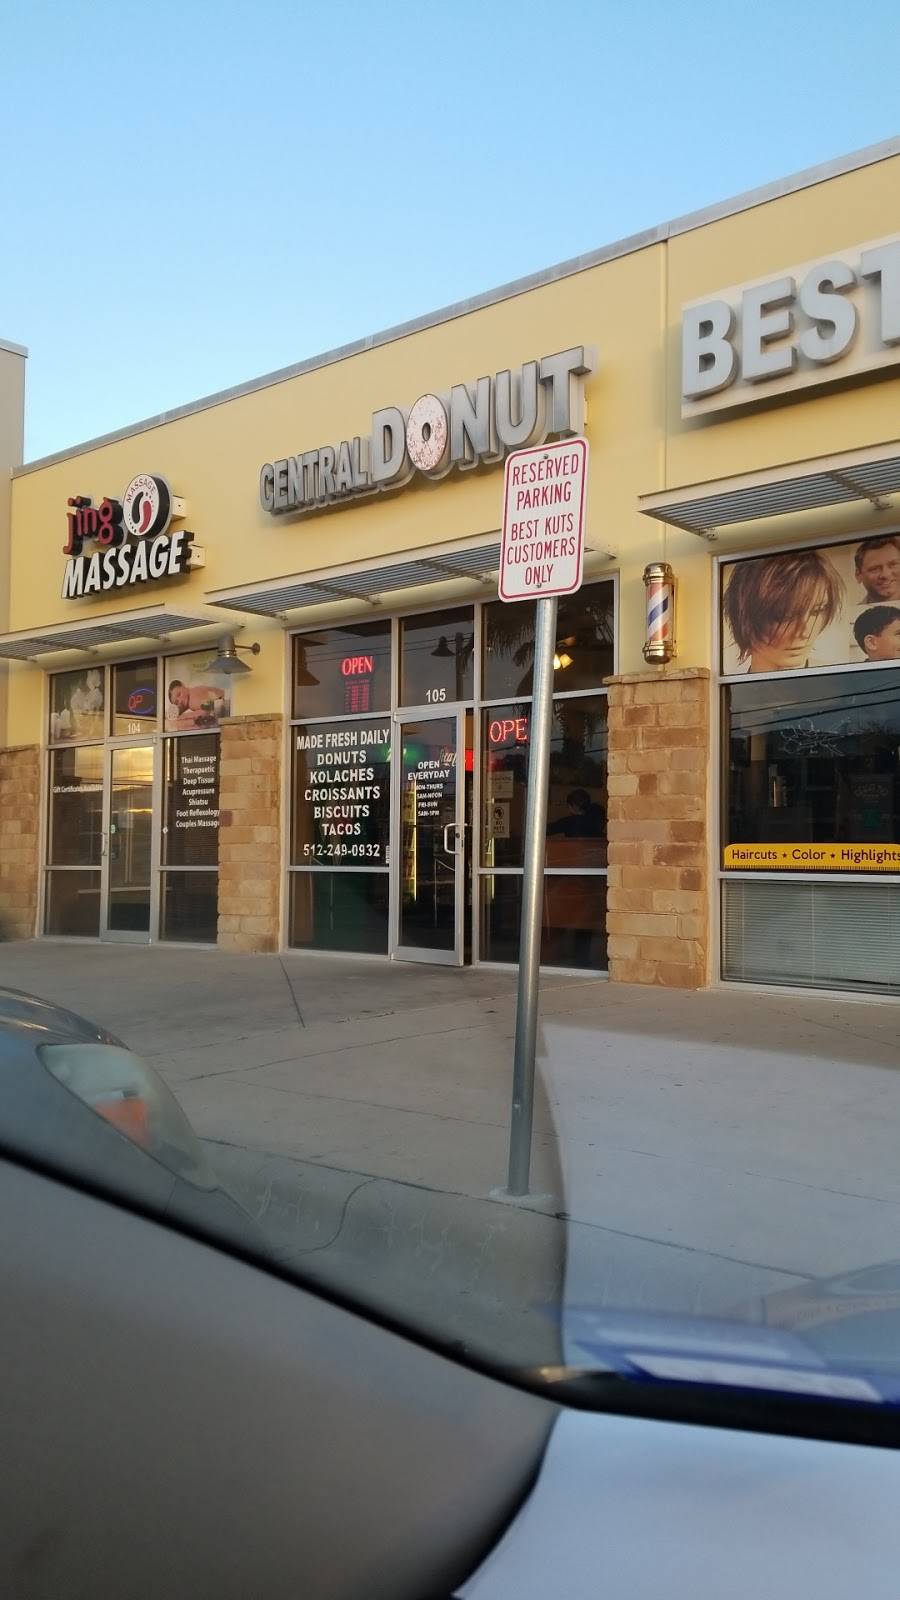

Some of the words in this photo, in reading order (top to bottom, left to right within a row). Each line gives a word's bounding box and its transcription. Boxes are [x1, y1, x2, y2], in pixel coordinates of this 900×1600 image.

[682, 240, 900, 399] BEST
[261, 436, 368, 513] CENTRAL
[372, 345, 588, 483] DONUT
[512, 453, 579, 486] RESERVED
[126, 478, 156, 503] MASSAGE
[516, 481, 572, 511] PARKING
[63, 495, 116, 555] jing
[511, 519, 539, 541] BEST
[544, 513, 574, 535] KUTS
[507, 536, 576, 565] CUSTOMERS
[61, 530, 186, 599] MASSAGE
[524, 563, 554, 586] ONLY
[341, 655, 374, 676] OPEN
[425, 687, 446, 703] 105
[127, 722, 141, 734] 104
[489, 718, 528, 743] OPE
[296, 734, 324, 750] MADE
[325, 731, 358, 748] FRESH
[361, 729, 390, 745] DAILY
[181, 755, 193, 764] Thai
[193, 755, 217, 764] Massage
[317, 749, 367, 766] DONUTS
[417, 760, 440, 770] OPEN
[183, 777, 197, 786] Deep
[197, 776, 215, 785] Tissue
[310, 767, 375, 784] KOLACHES
[407, 769, 450, 781] EVERYDAY
[182, 787, 215, 797] Acupressure
[304, 786, 381, 802] CROISSANTS
[176, 809, 188, 817] Foot
[189, 808, 220, 818] Reflexology
[314, 804, 370, 819] BISCUITS
[176, 820, 197, 830] Couples
[321, 822, 361, 836] TACOS
[303, 843, 380, 857] 512-249-0932
[732, 849, 778, 861] Haircuts
[791, 849, 826, 861] Color
[841, 849, 900, 864] Highlights
